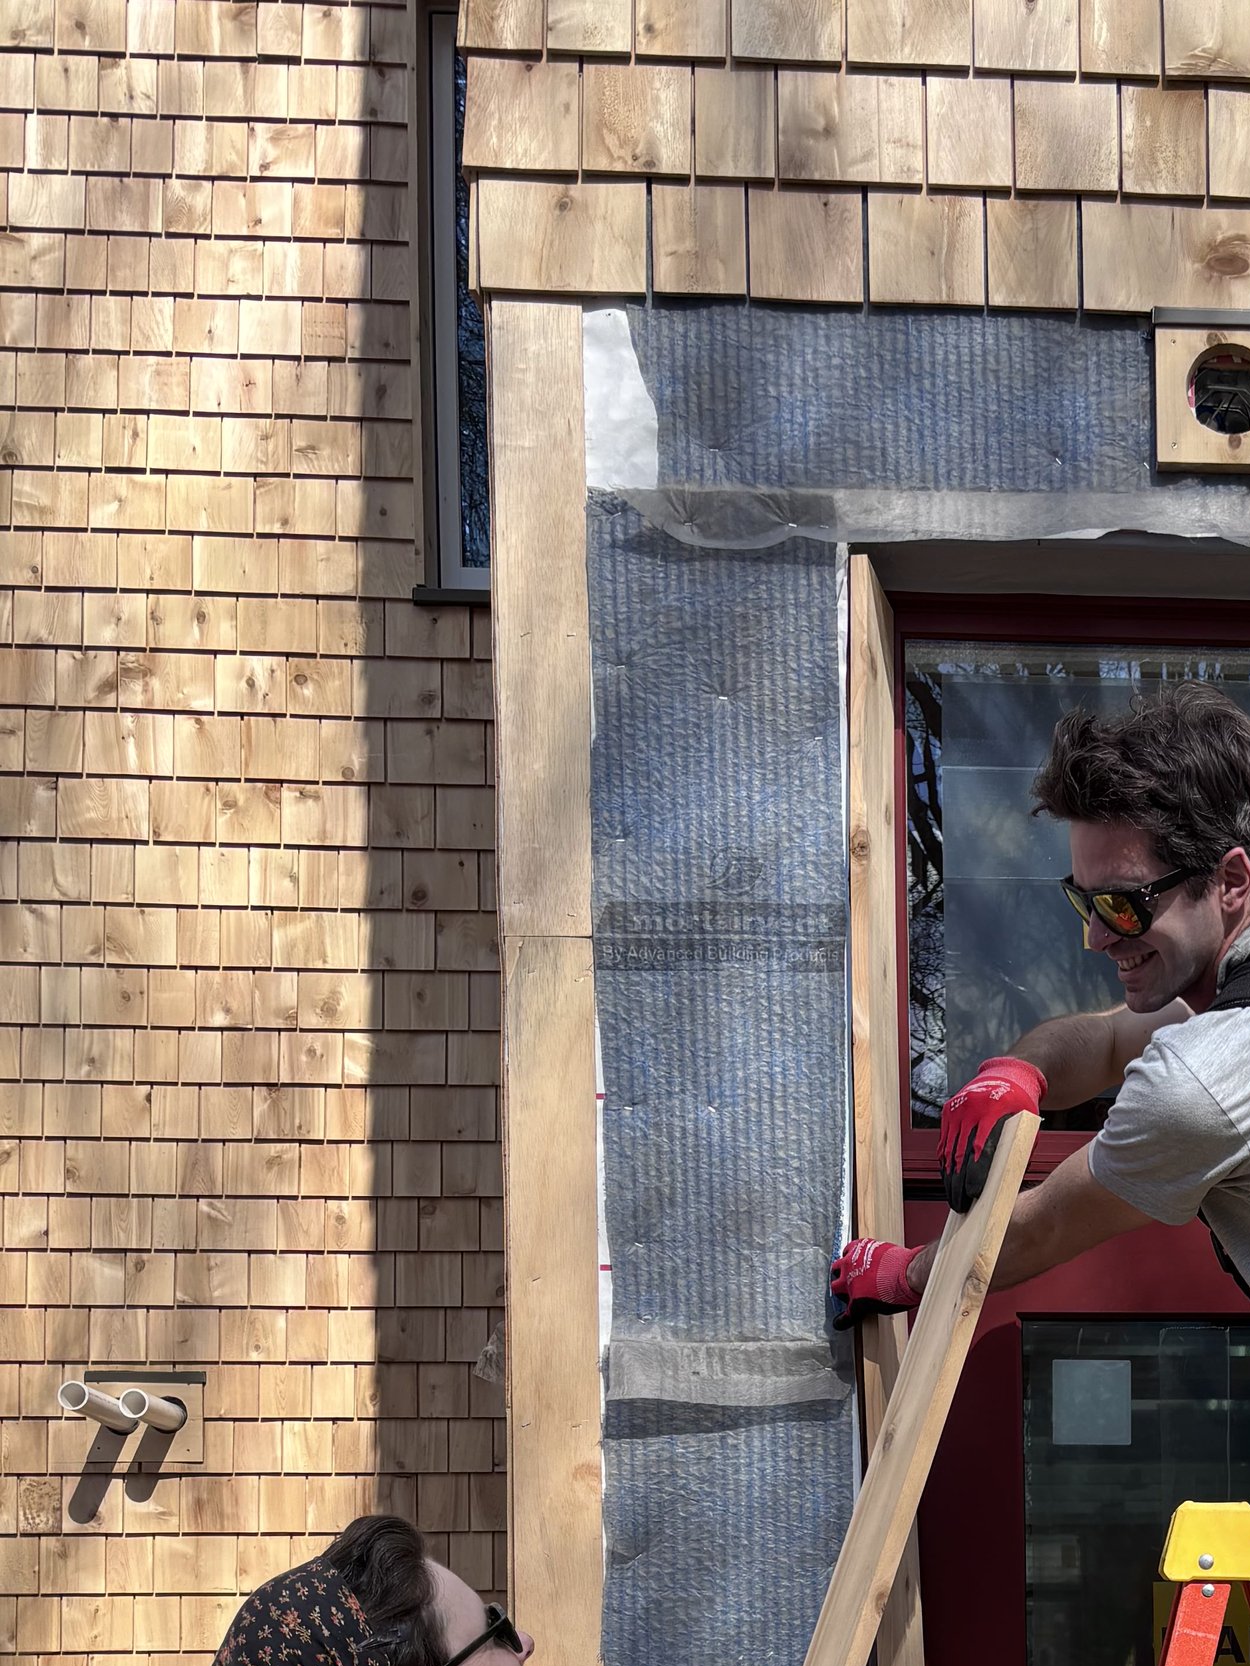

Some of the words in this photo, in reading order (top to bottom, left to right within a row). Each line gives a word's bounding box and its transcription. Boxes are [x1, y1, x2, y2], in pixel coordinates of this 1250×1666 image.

[627, 945, 702, 962] Advanced
[707, 945, 771, 963] Building
[774, 946, 839, 963] Products
